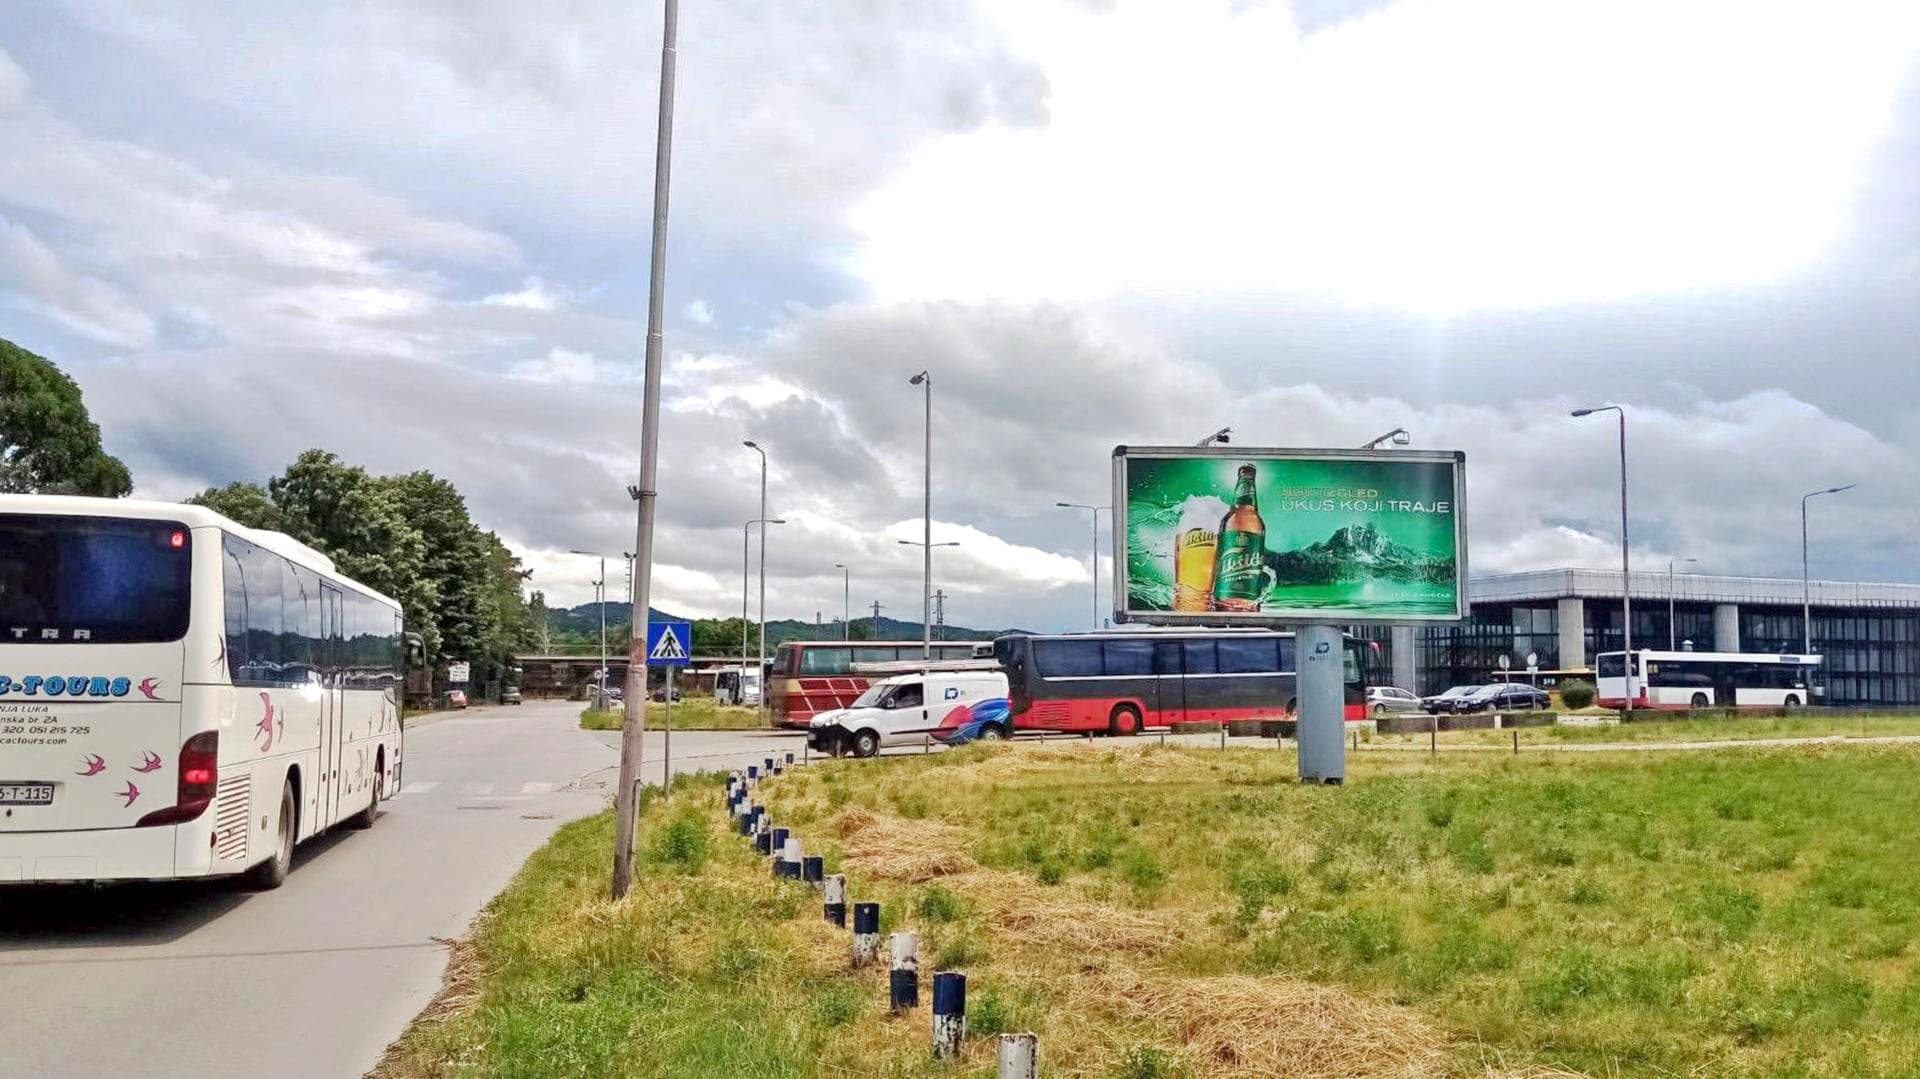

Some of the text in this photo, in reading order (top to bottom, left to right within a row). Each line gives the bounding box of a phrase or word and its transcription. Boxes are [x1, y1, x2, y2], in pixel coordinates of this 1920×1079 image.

[1281, 500, 1450, 513] UKUS KOJI TRAJE
[11, 627, 91, 640] TRA
[21, 705, 49, 713] LUKA
[43, 715, 58, 724] 2A
[29, 725, 48, 734] 051
[49, 726, 67, 735] 215
[70, 726, 91, 735] 725
